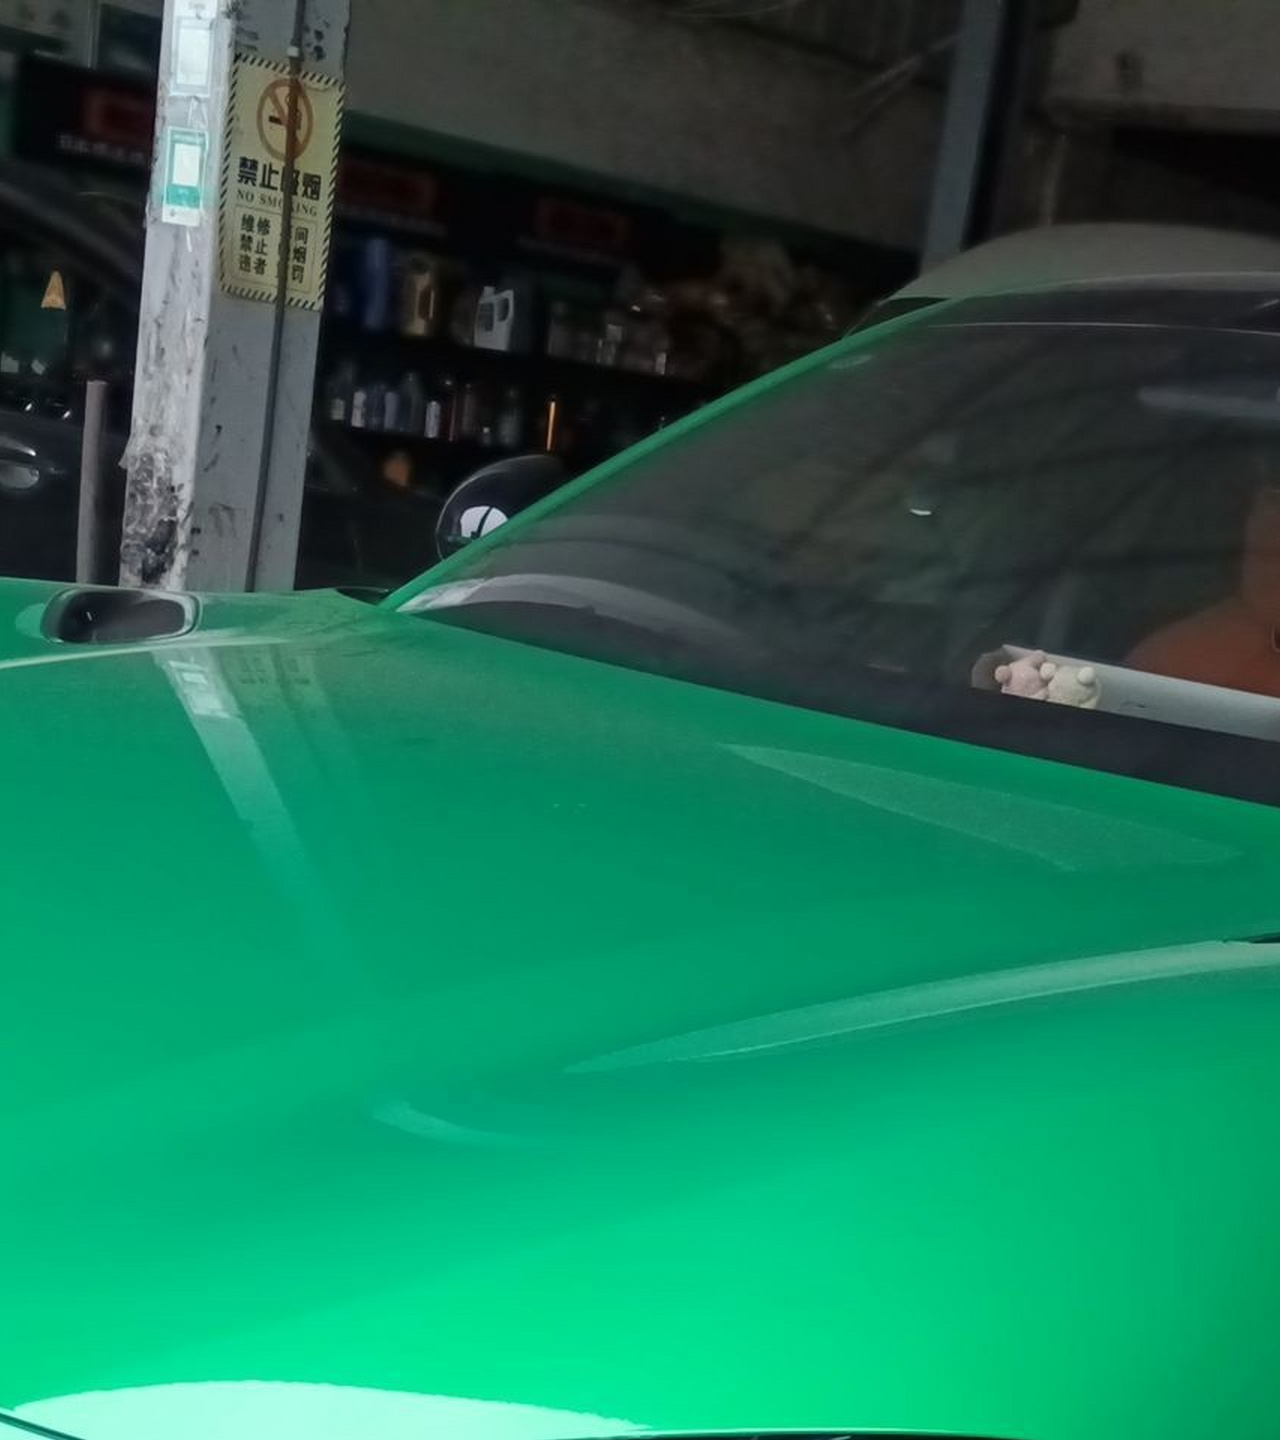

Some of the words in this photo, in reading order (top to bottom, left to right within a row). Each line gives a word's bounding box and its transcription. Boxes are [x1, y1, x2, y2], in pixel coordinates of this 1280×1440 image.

[237, 189, 255, 203] NO
[260, 193, 318, 217] SMING
[241, 213, 309, 245] 维修间
[240, 234, 307, 265] 禁止烟
[238, 253, 305, 285] 违者罚
